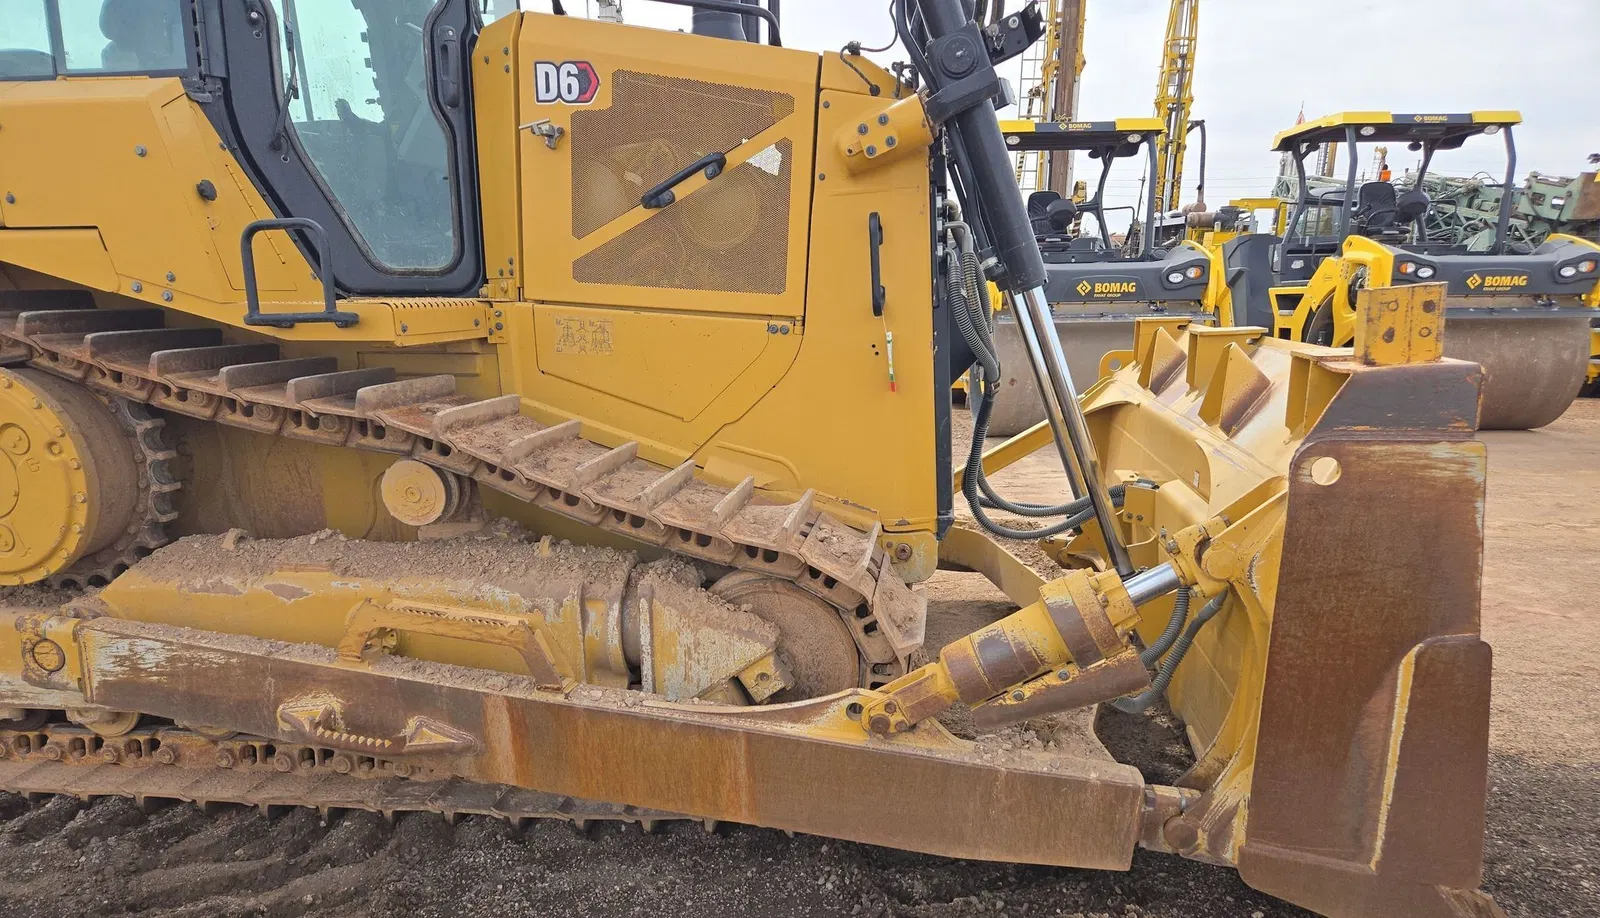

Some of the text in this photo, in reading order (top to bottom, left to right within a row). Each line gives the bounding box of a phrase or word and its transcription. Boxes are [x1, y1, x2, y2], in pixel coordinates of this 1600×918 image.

[535, 62, 580, 101] D6
[1484, 275, 1528, 287] BOMAG
[1094, 282, 1136, 293] BOMAG
